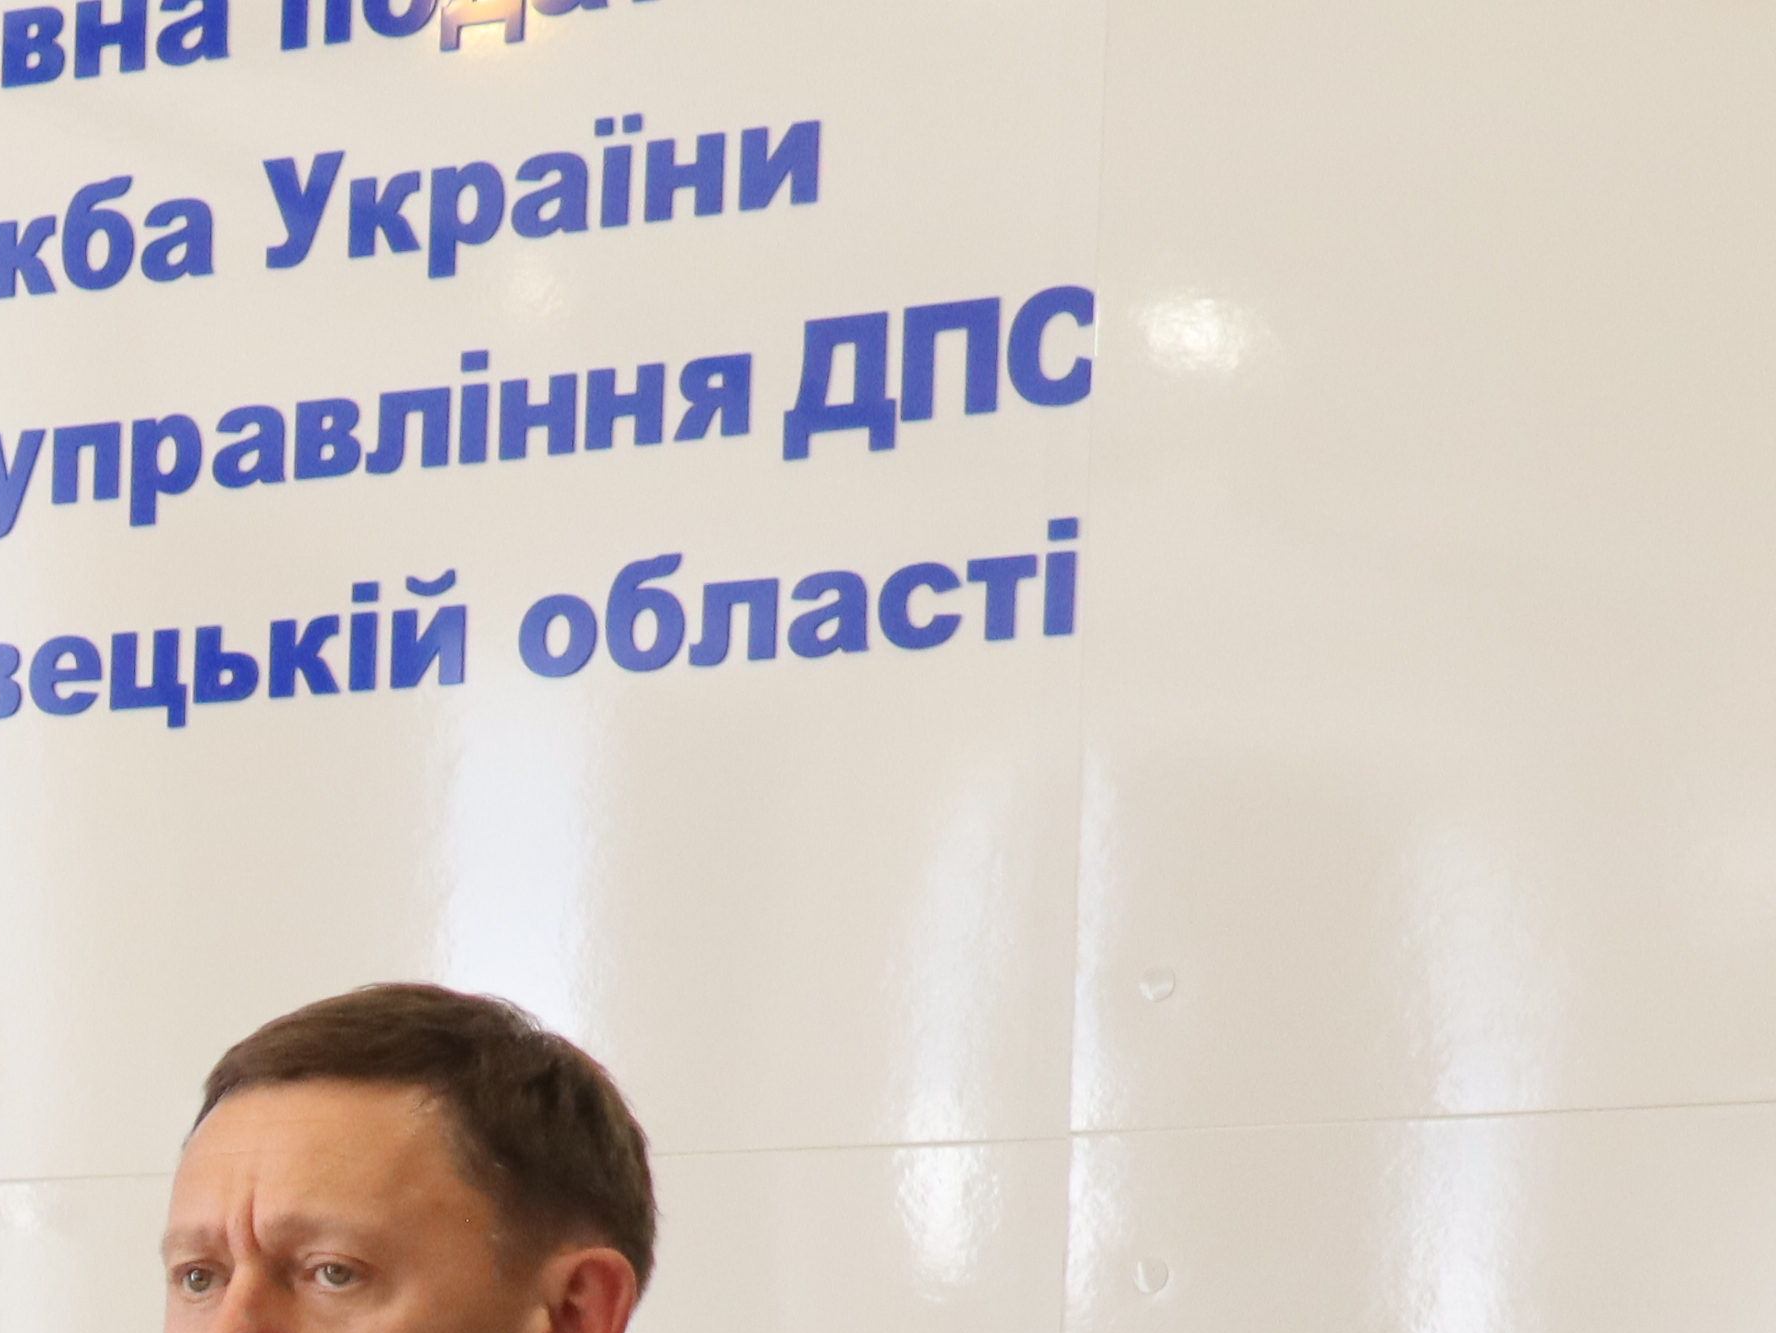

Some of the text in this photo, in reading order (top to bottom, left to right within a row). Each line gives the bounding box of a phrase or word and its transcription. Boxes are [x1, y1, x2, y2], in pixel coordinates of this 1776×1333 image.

[262, 113, 822, 281] України
[782, 285, 1096, 462] ДПС
[518, 516, 1080, 680] області
